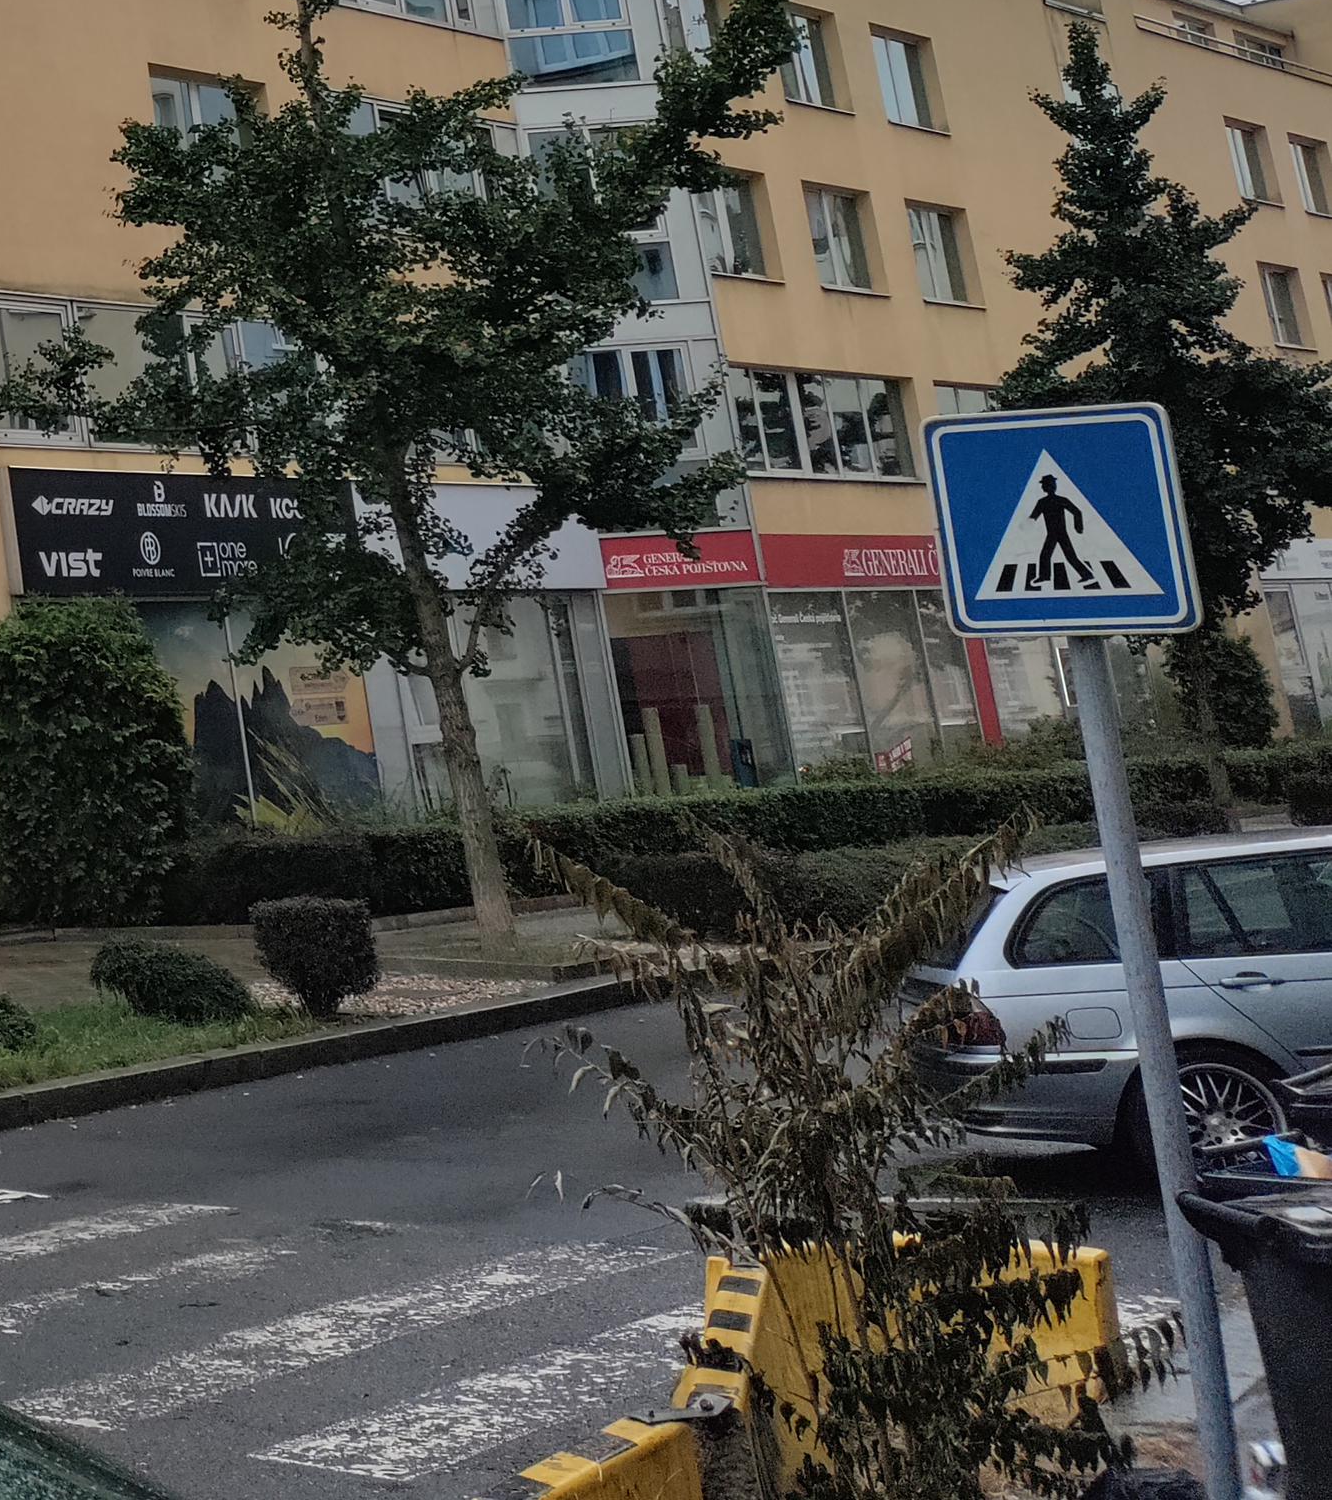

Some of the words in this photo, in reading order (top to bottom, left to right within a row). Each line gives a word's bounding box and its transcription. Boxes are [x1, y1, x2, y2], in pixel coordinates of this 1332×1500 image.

[51, 497, 114, 516] CRAZY
[218, 541, 247, 558] one
[645, 563, 681, 577] ČESKÁ
[861, 548, 929, 577] GENERALI
